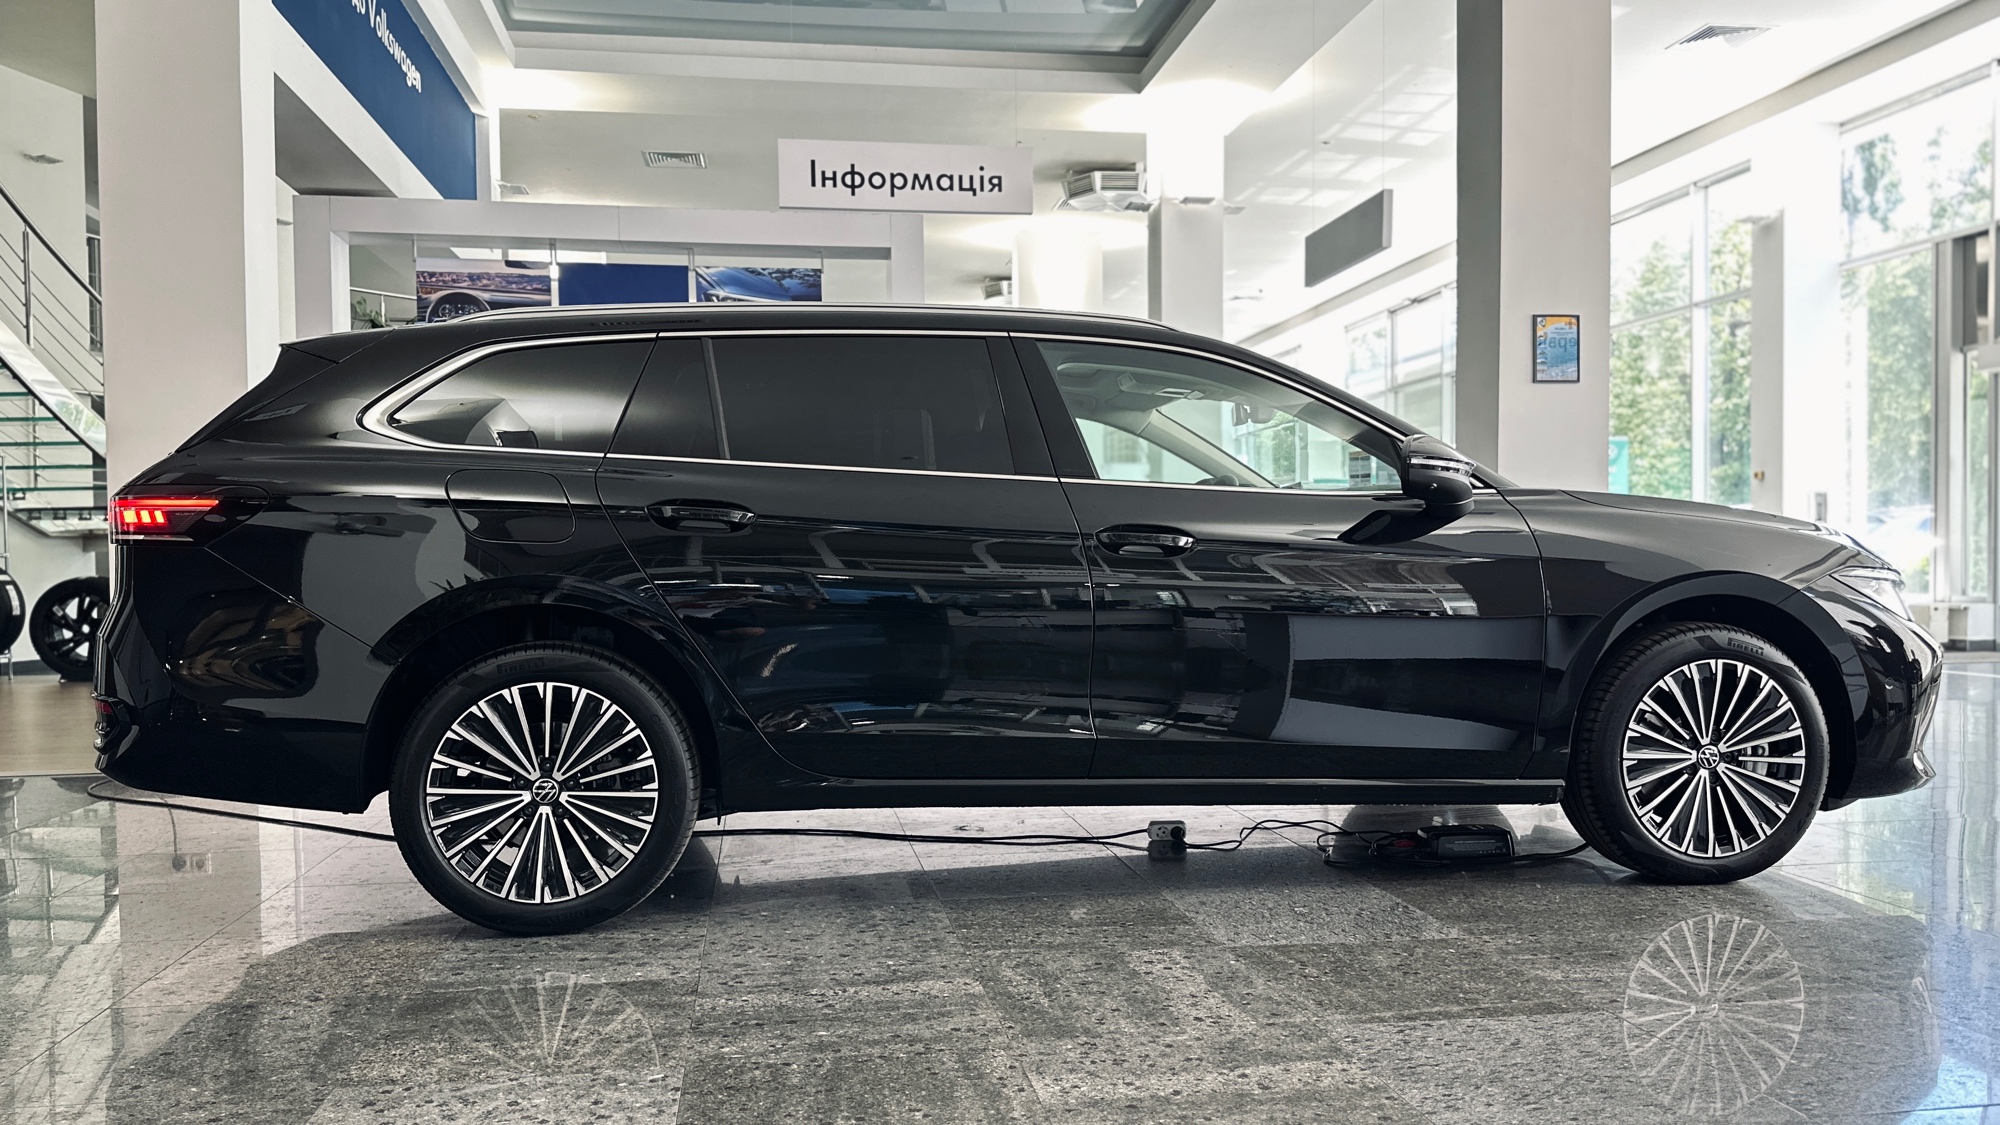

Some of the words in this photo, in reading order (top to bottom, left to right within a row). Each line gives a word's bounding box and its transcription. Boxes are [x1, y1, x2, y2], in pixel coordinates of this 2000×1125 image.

[367, 0, 422, 94] Volkswagen
[810, 159, 1003, 198] Інформація
[1727, 636, 1765, 657] PIRELLI
